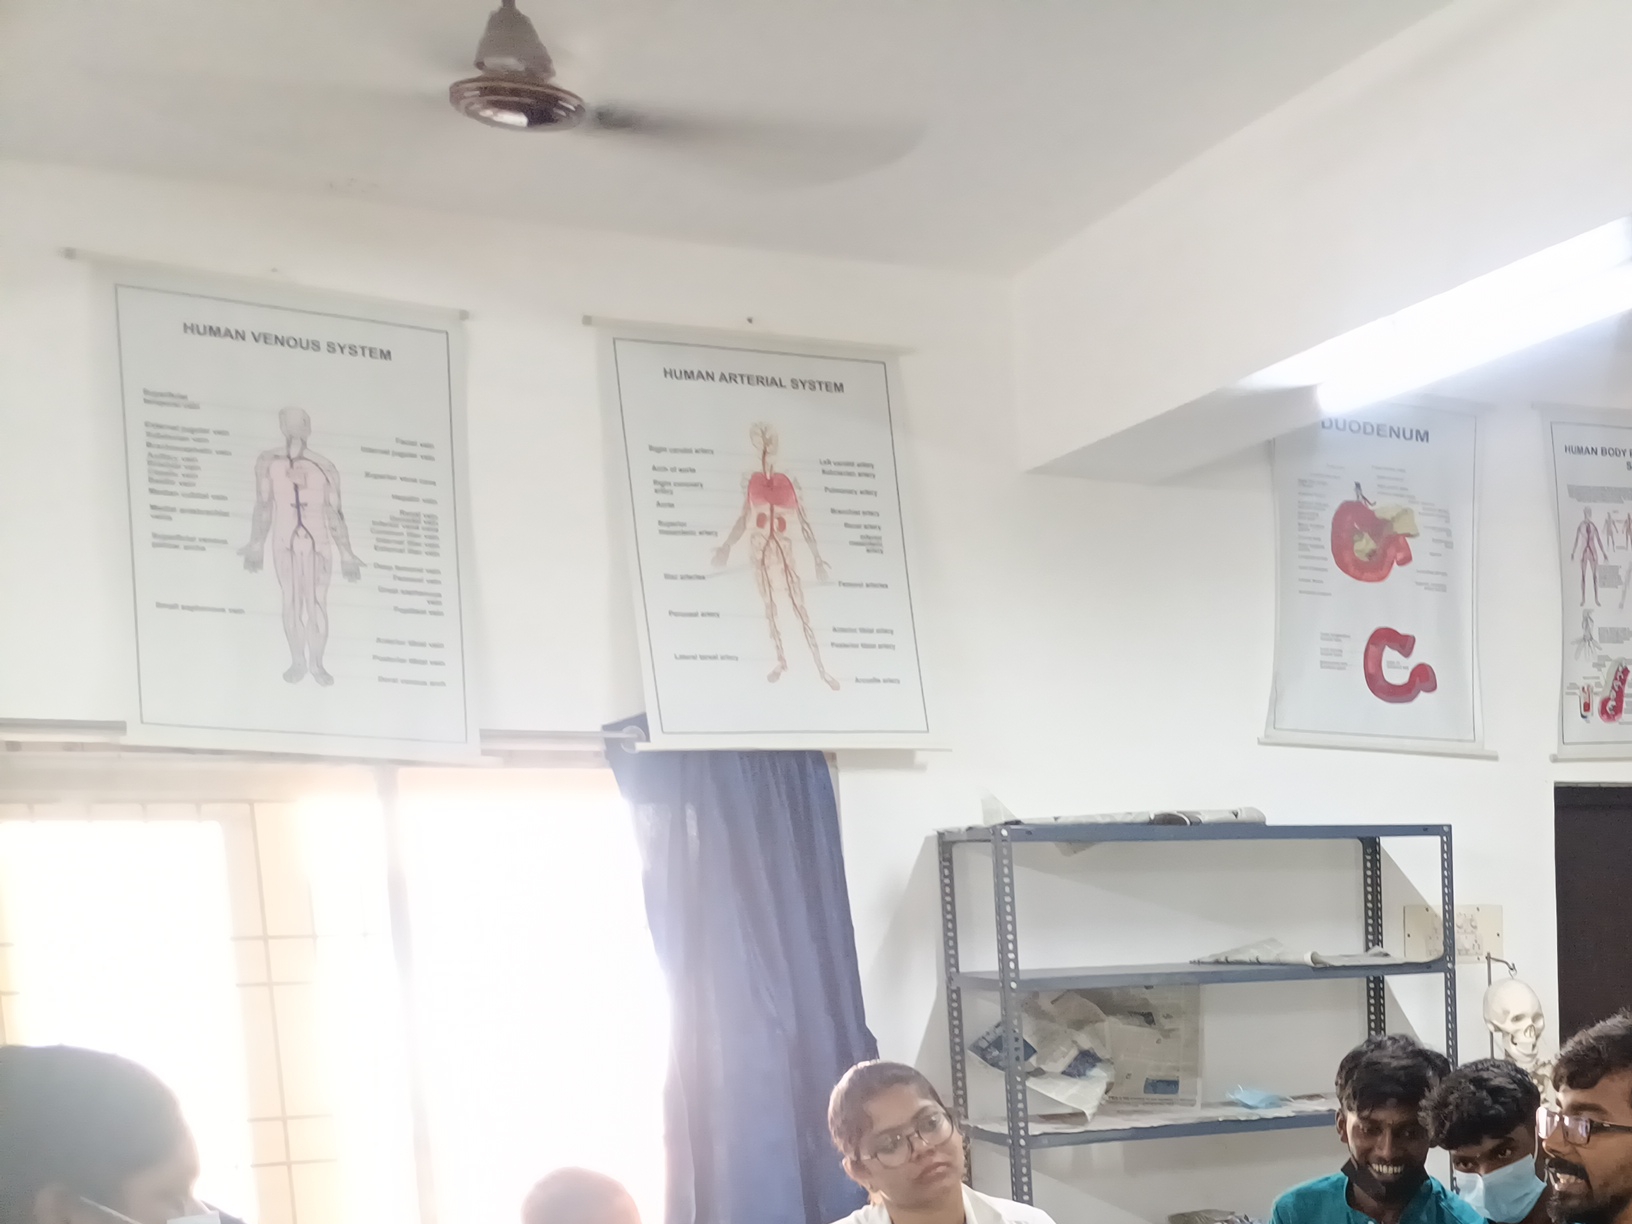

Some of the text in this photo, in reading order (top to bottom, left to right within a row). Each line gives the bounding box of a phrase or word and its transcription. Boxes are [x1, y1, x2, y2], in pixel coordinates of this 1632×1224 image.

[183, 322, 392, 361] HUMAN VENOUS SYSTEM
[663, 367, 845, 393] HUMAN ARTERIAL SYSTEM
[1321, 417, 1430, 443] DUODENUM
[1564, 444, 1598, 456] HUMAN
[1600, 446, 1627, 458] BODY
